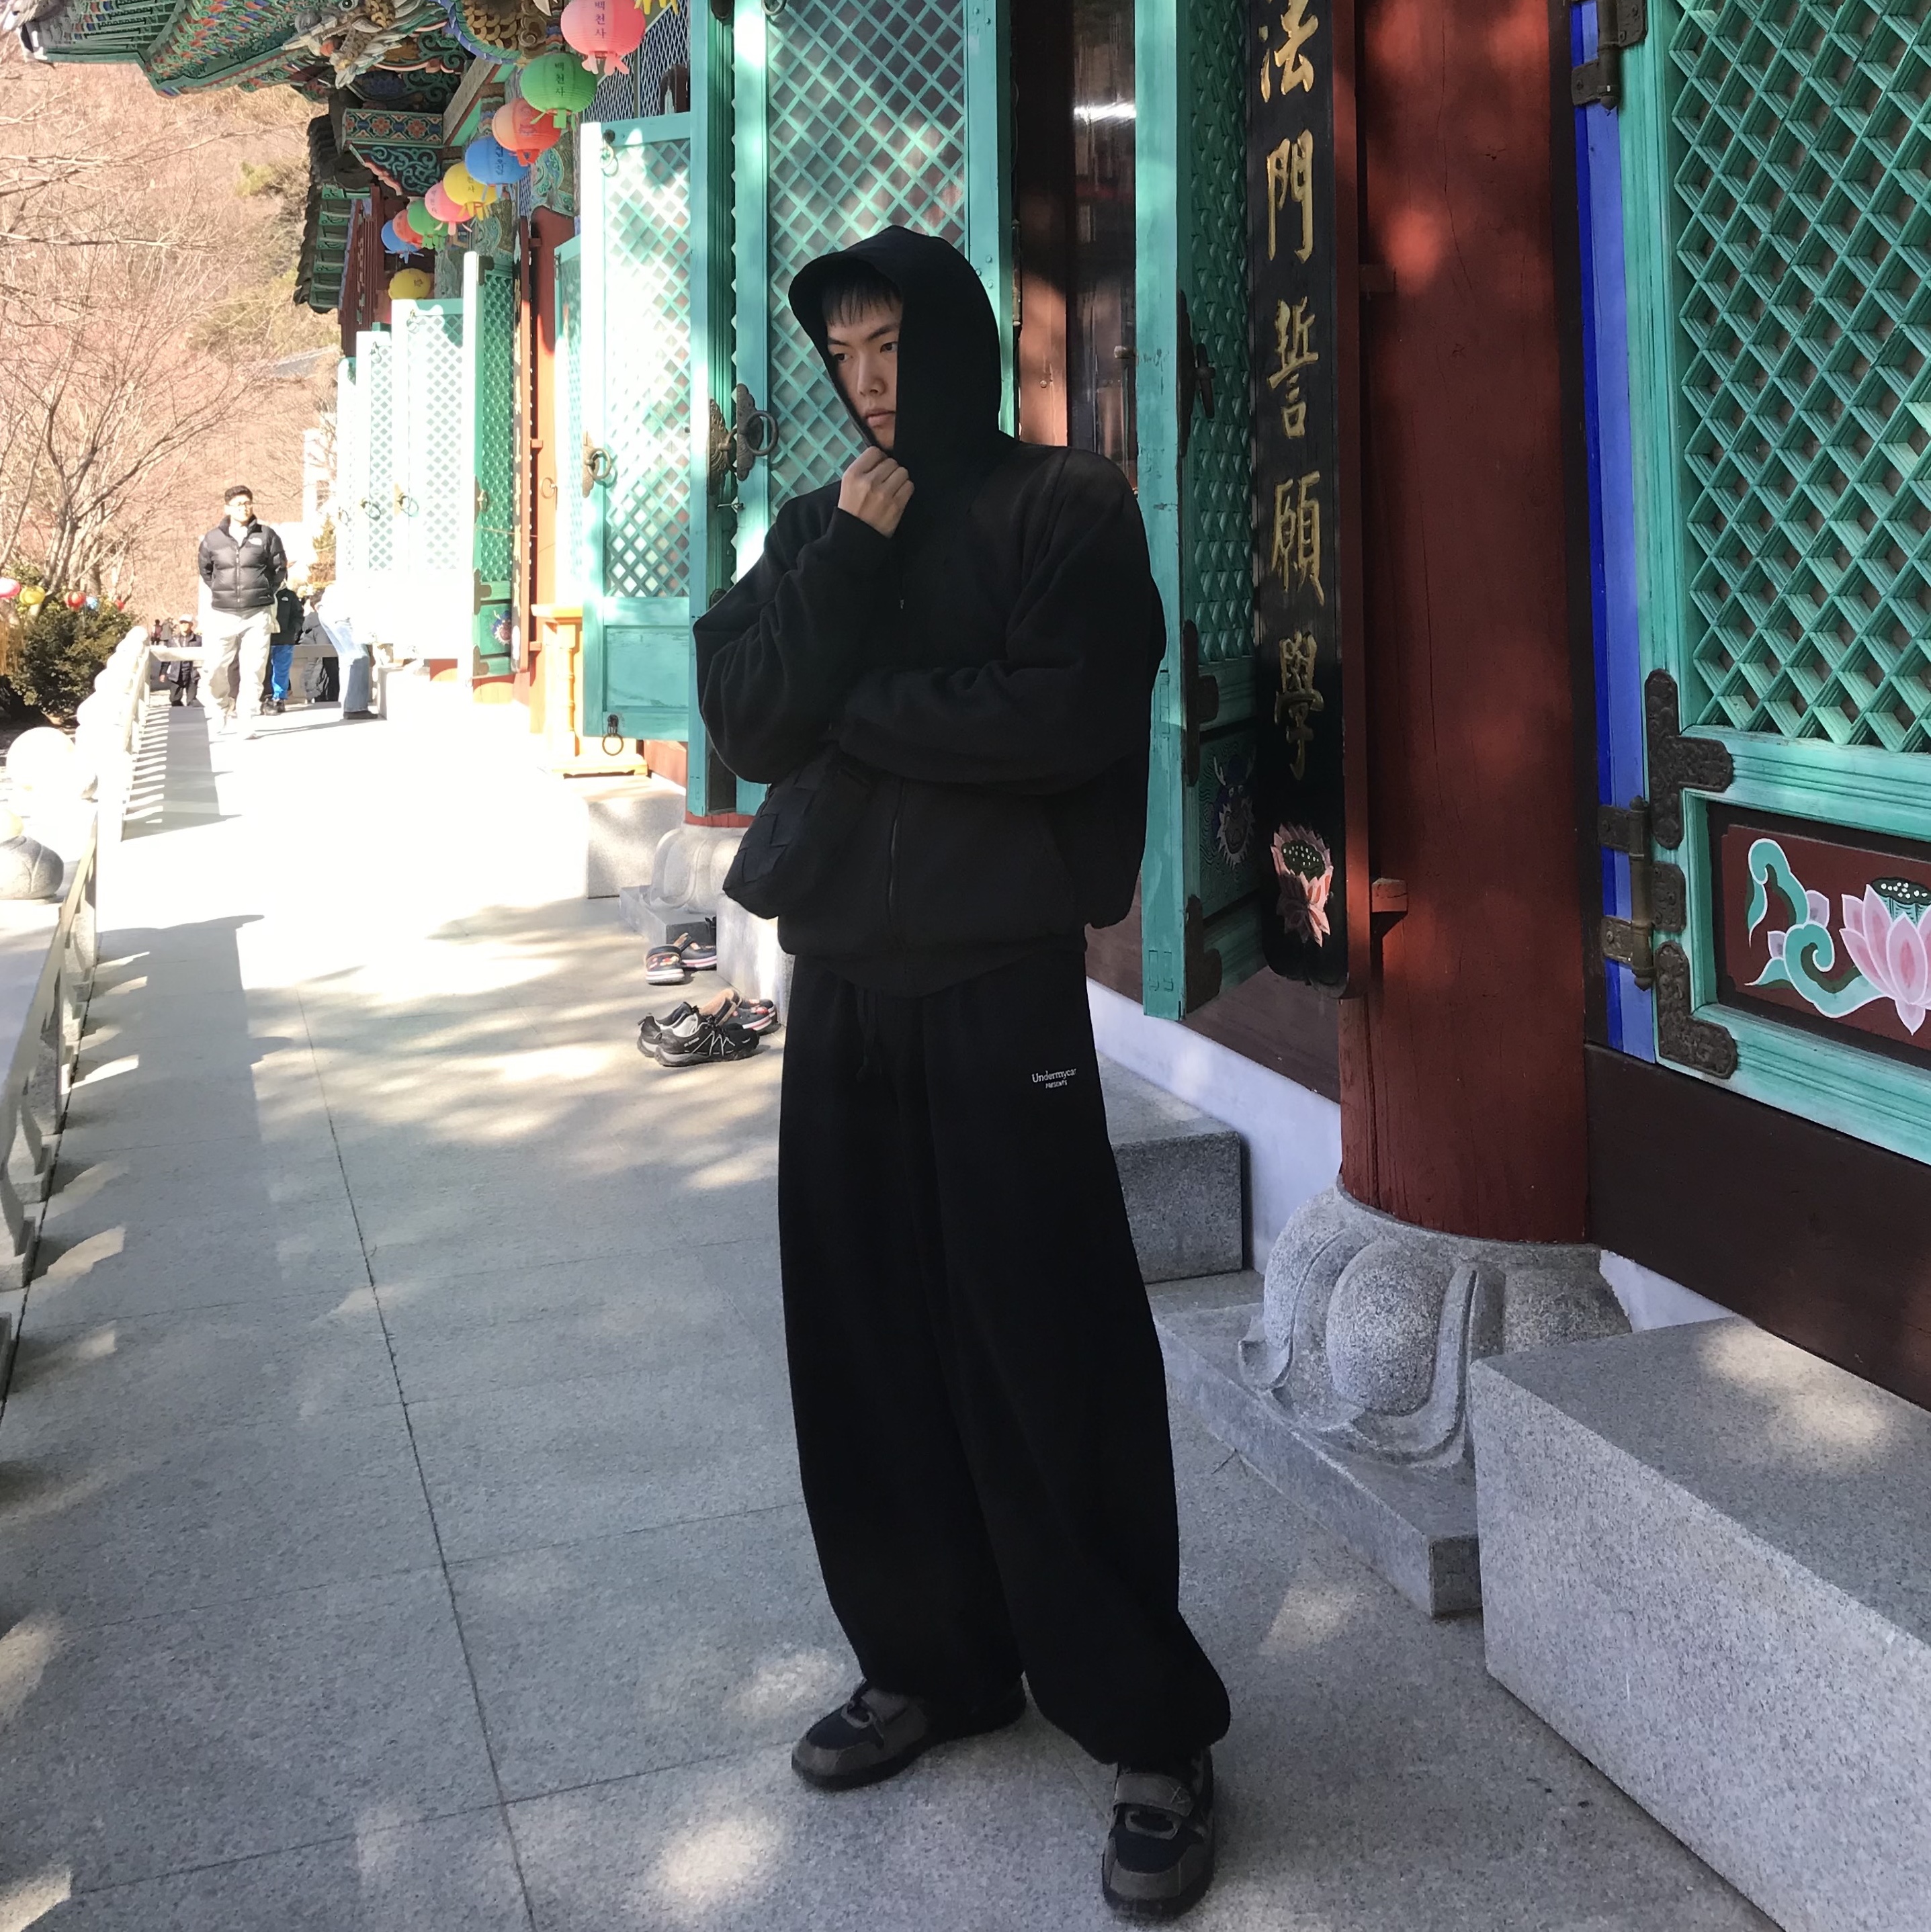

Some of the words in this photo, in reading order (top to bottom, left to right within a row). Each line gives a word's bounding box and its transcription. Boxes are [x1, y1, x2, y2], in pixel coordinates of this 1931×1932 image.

[595, 0, 606, 38] 백천사
[554, 62, 565, 96] 백천사
[1032, 1068, 1076, 1083] Undermycar
